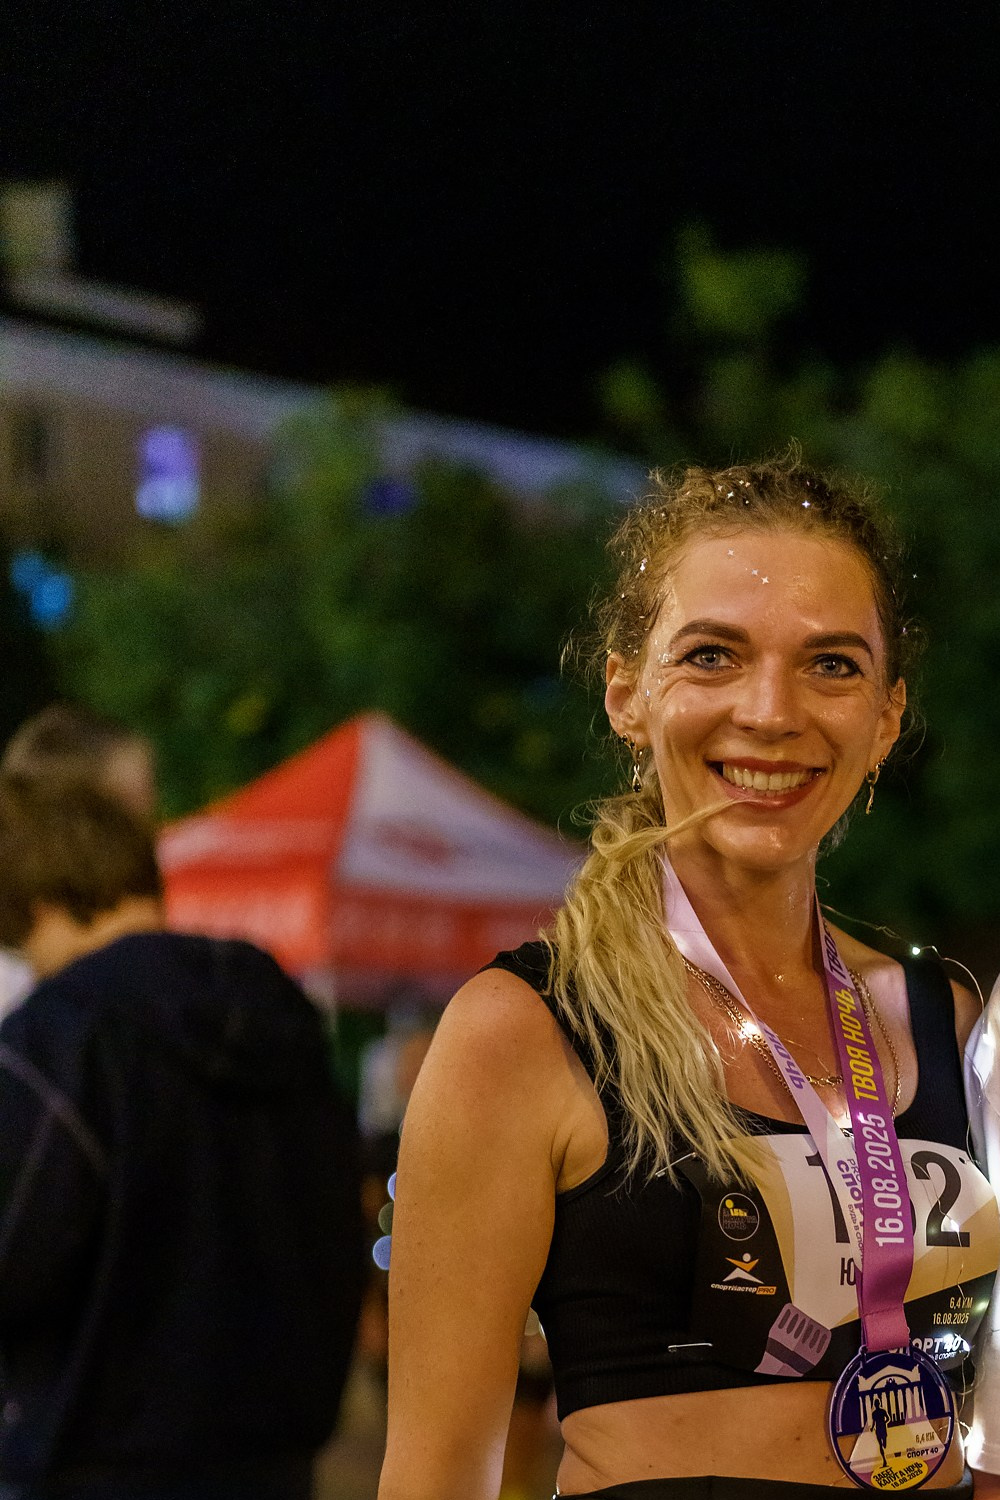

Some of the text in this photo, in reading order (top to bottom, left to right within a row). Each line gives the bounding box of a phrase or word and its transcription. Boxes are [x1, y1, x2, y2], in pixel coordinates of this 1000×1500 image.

[846, 1045, 880, 1101] ТВОЯ
[806, 1149, 970, 1248] 12
[861, 1113, 906, 1247] 16.08.2025
[757, 1286, 775, 1294] PRO
[906, 1448, 930, 1459] СПОРТ
